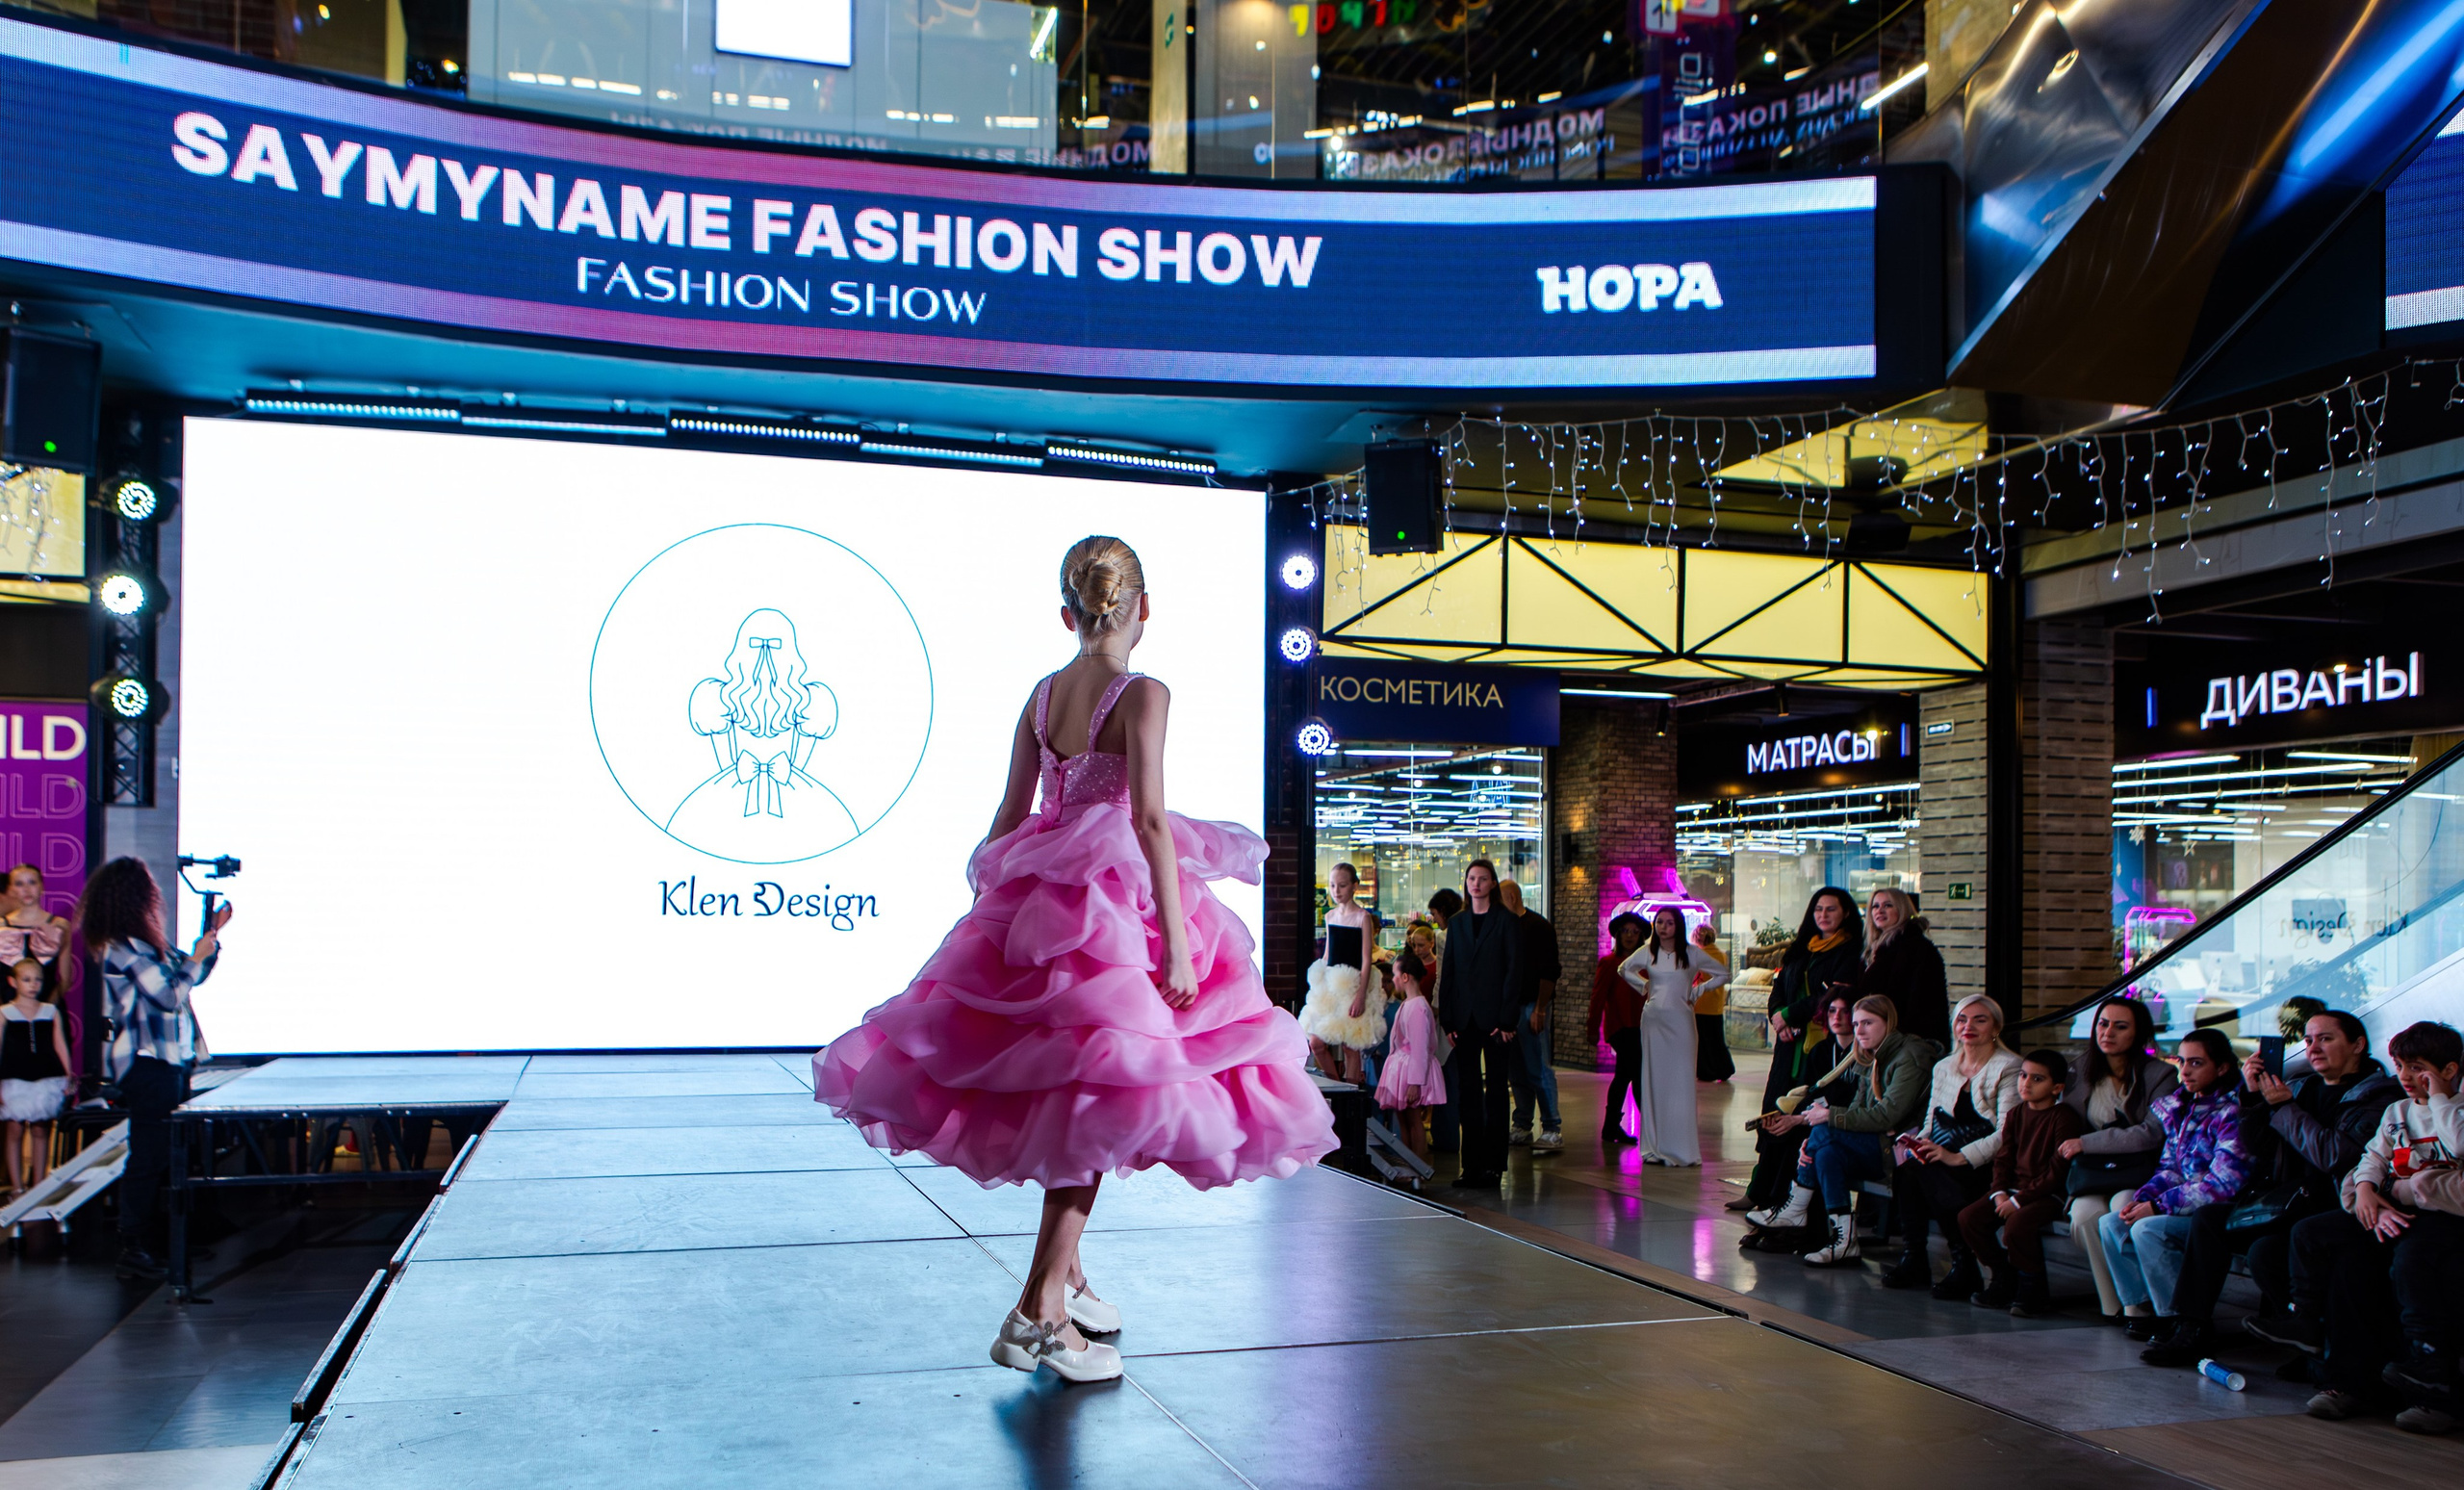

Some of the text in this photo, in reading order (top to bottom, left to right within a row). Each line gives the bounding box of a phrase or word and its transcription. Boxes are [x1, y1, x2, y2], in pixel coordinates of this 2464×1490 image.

[171, 112, 1323, 289] SAYMYNAME FASHION SHOW
[578, 256, 988, 325] FASHION SHOW
[1320, 676, 1504, 708] КОСМЕТИКА
[2200, 652, 2421, 730] ДИВАНЫ
[1747, 730, 1877, 774] МАТРАСЫ
[657, 875, 880, 931] Klen Design
